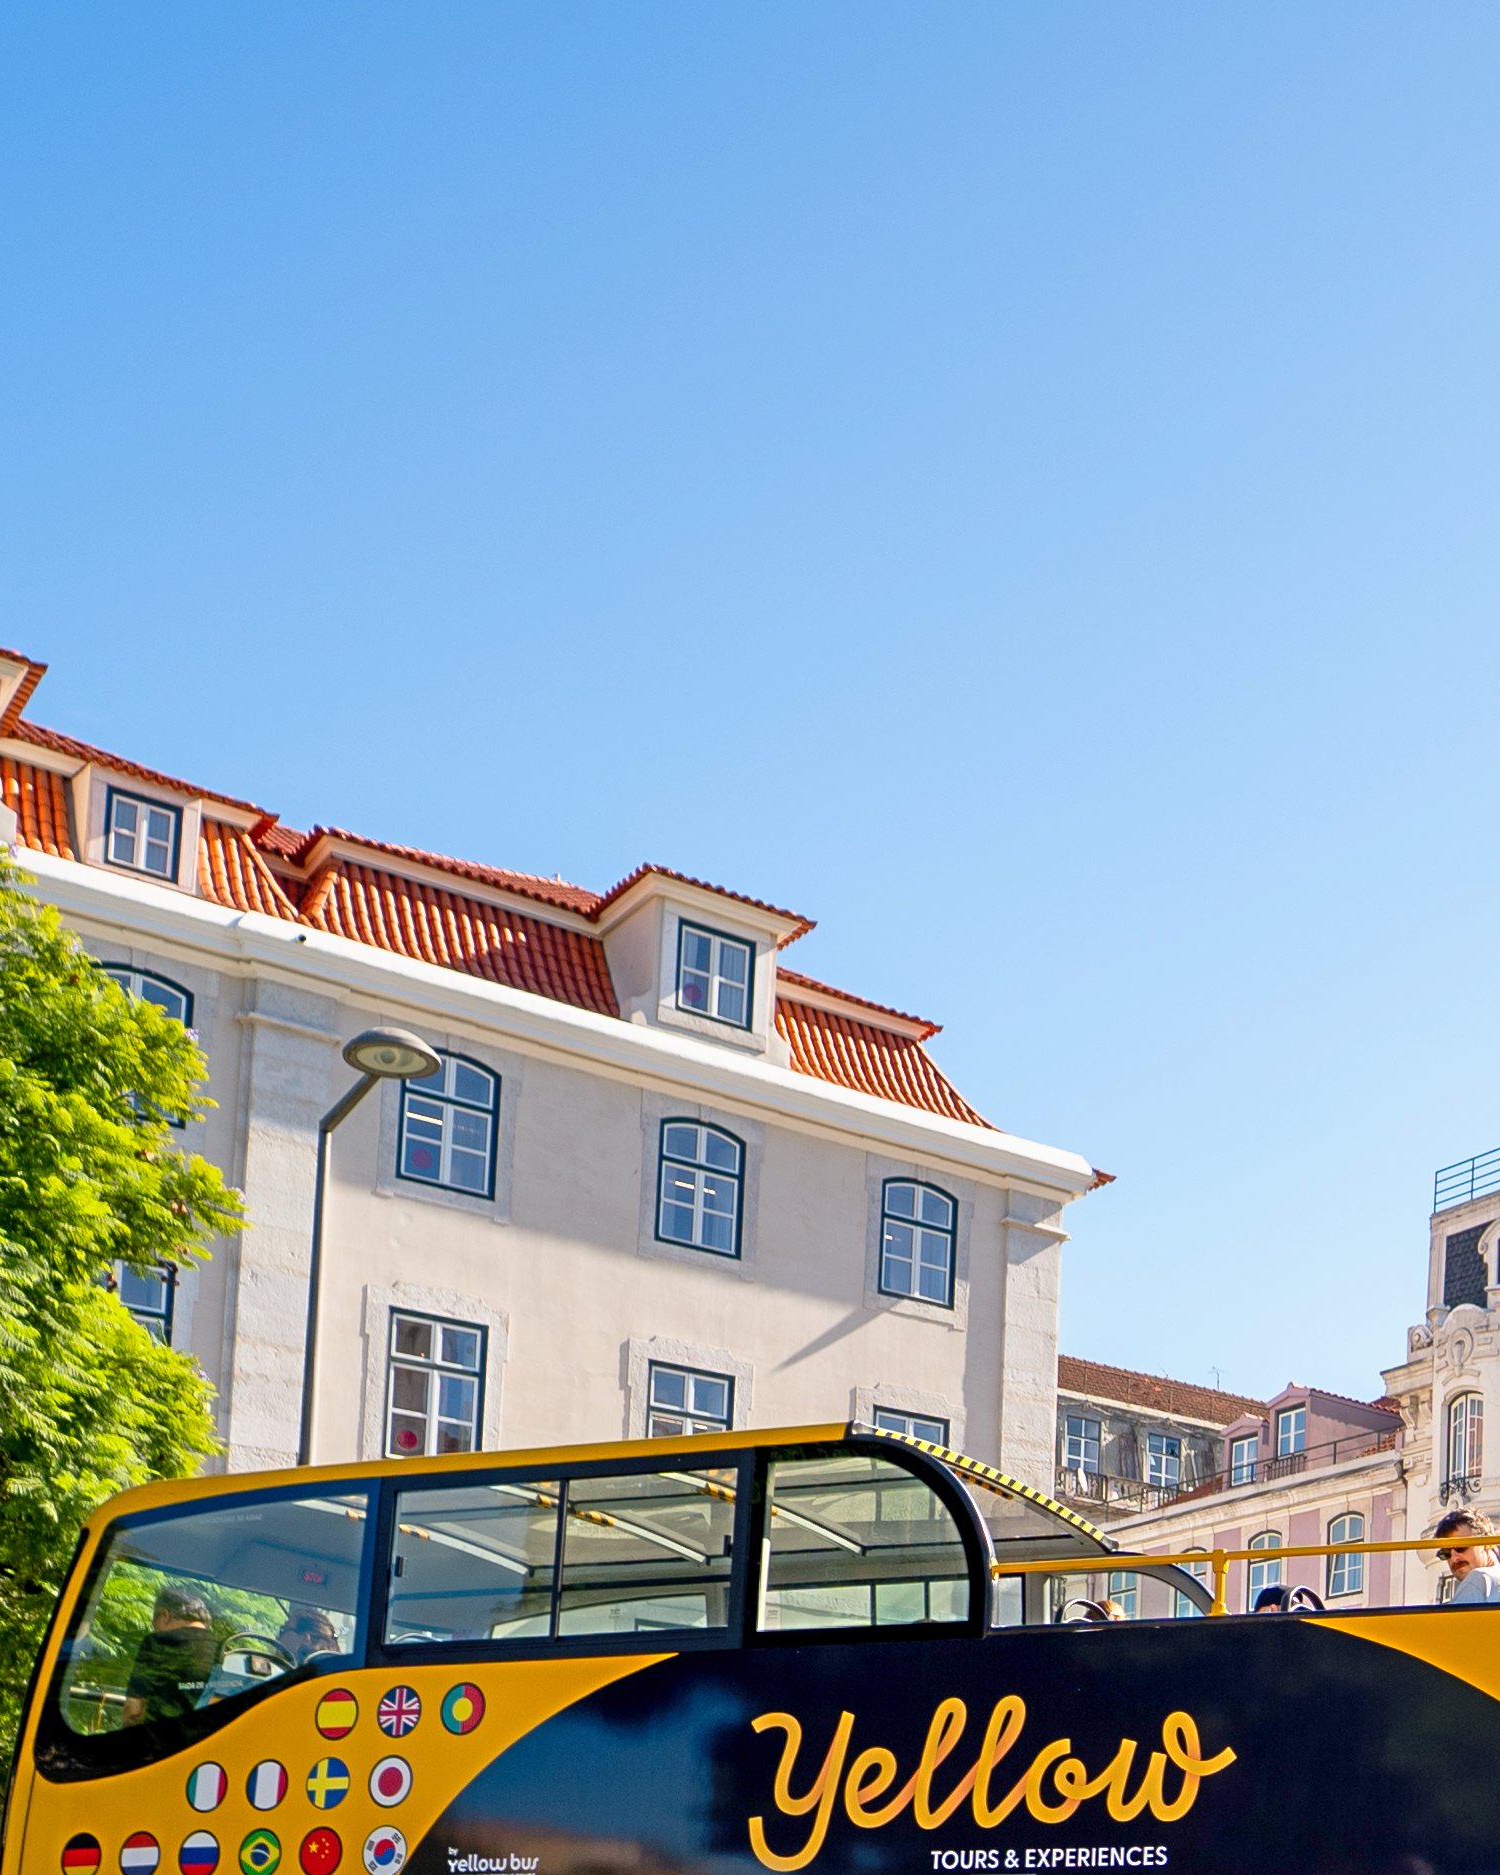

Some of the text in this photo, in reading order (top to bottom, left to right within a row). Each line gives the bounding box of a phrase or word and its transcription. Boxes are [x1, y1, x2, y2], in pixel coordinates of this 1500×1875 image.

[509, 1852, 540, 1871] bus
[930, 1846, 1169, 1870] TOURS & EXPERIENCES
